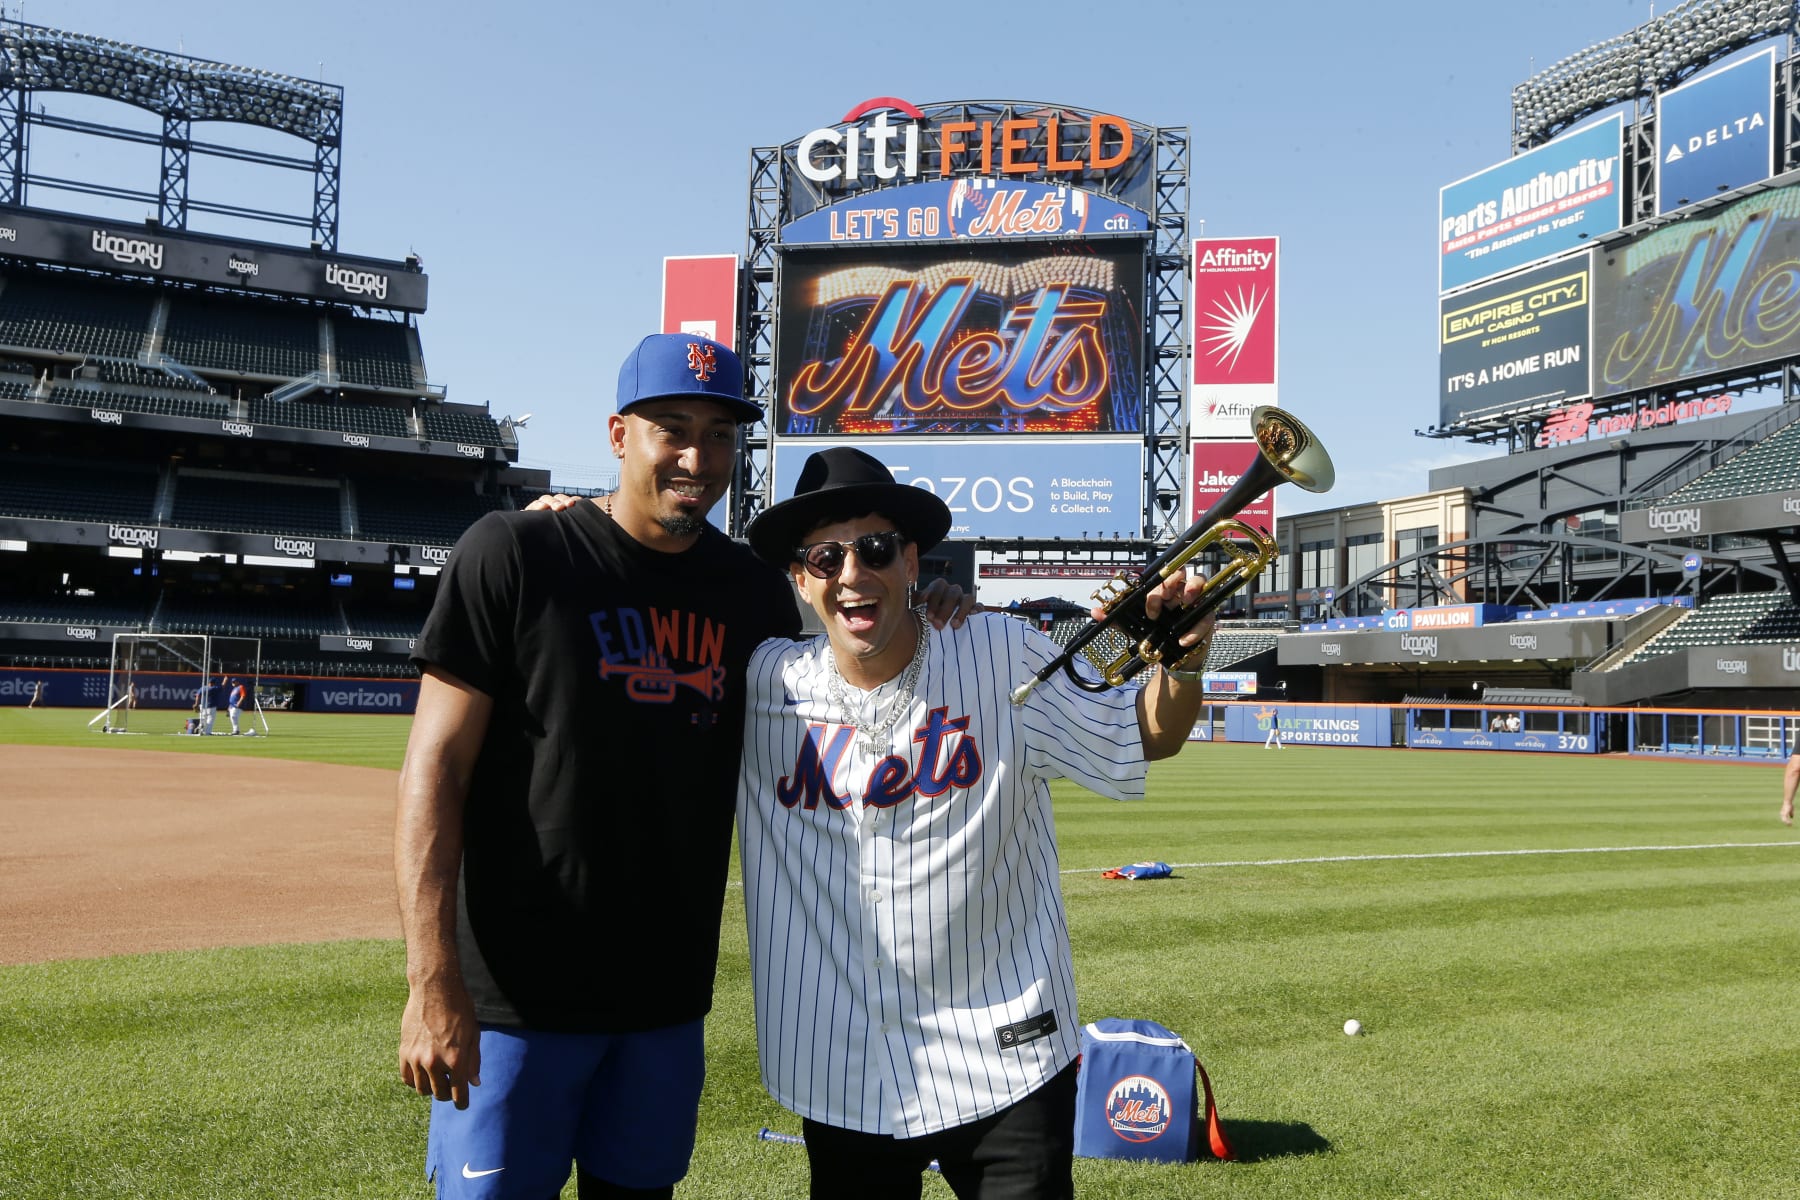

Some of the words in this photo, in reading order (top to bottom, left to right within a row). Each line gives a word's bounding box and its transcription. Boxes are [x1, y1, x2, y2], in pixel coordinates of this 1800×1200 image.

[1689, 112, 1764, 153] DELTA
[797, 111, 919, 182] citi
[940, 115, 1134, 176] FIELD
[1443, 200, 1497, 242] Parts
[1501, 157, 1613, 220] Authority
[830, 207, 899, 241] LET'S
[908, 206, 940, 237] GO
[968, 189, 1063, 236] Mets
[1104, 216, 1129, 231] citi
[1447, 234, 1475, 252] Auto
[1478, 221, 1512, 242] Parts
[1514, 206, 1555, 228] Super
[1558, 186, 1608, 210] Stores
[92, 230, 163, 270] timmy
[1491, 228, 1535, 251] Answer
[229, 258, 259, 276] timmy
[1200, 248, 1273, 270] Affinity
[326, 264, 387, 300] timmy
[1450, 300, 1524, 333] EMPIRE
[1487, 312, 1534, 333] CASINO
[1508, 325, 1540, 341] RESORTS
[788, 276, 1109, 414] Mets
[1448, 372, 1475, 392] IT'S
[1477, 369, 1489, 386] A
[1492, 355, 1540, 382] HOME
[1544, 345, 1580, 370] RUN
[1597, 411, 1638, 435] new
[1642, 394, 1732, 427] balance
[1051, 479, 1059, 488] A
[1061, 478, 1112, 488] Blockchain
[1050, 491, 1060, 501] to
[1063, 491, 1089, 502] Build,
[1092, 491, 1112, 502] Play
[1050, 504, 1057, 513] &
[1061, 504, 1093, 513] Collect
[1649, 508, 1700, 533] timmy
[109, 524, 158, 548] timmy
[275, 537, 315, 558] timmy
[1388, 612, 1408, 629] citi
[1415, 611, 1470, 627] PAVILION
[588, 607, 726, 671] EDWIN
[1401, 633, 1437, 658] timmy
[322, 688, 402, 706] verizon
[1281, 730, 1359, 743] SPORTSBOOK
[1413, 738, 1442, 746] workday
[1463, 739, 1492, 747] workday
[1514, 740, 1546, 749] workday
[1558, 735, 1588, 750] 370
[777, 706, 982, 811] Mets
[1115, 1099, 1161, 1124] Mets
